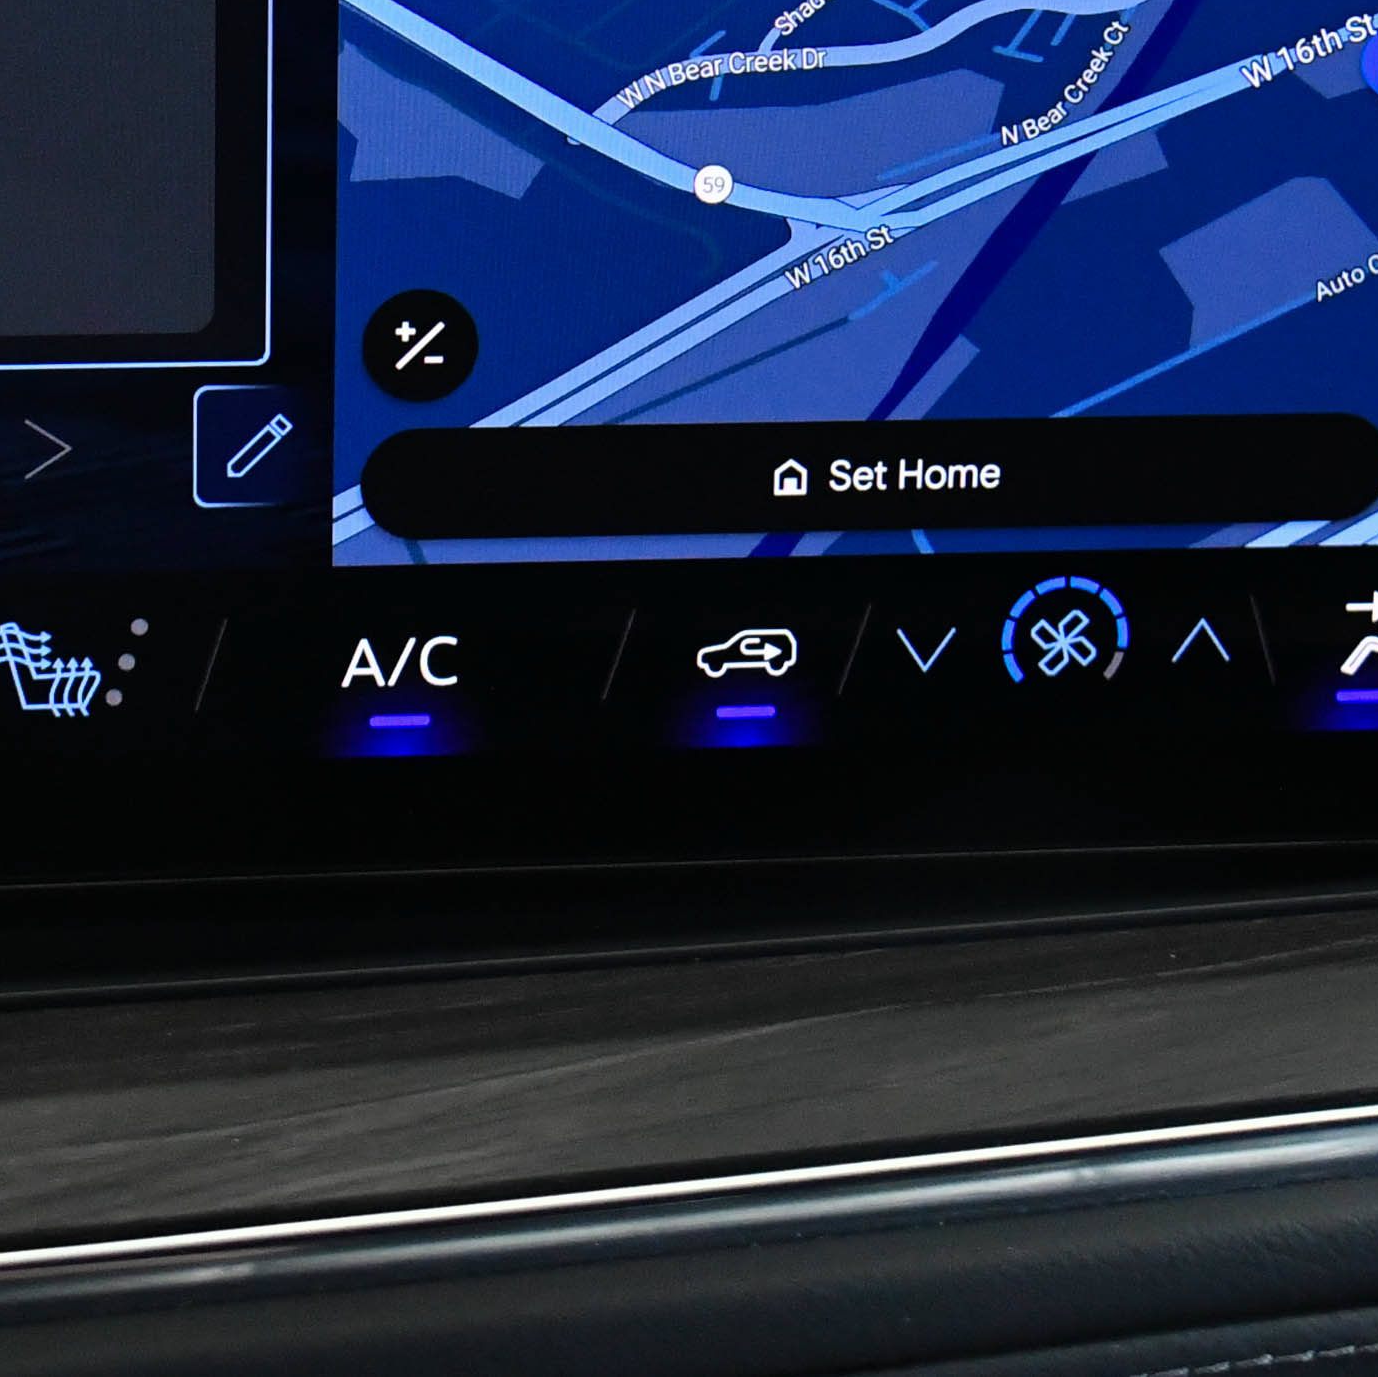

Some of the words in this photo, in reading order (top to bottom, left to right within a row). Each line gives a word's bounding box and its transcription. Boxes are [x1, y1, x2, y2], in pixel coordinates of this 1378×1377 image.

[616, 84, 644, 112] W
[643, 70, 671, 97] N
[667, 54, 724, 85] Bear
[727, 49, 797, 75] Creek
[800, 46, 828, 70] Dr
[1240, 56, 1273, 91] W
[1275, 23, 1344, 75] 16th
[1343, 12, 1378, 46] St
[1000, 124, 1022, 148] N
[1022, 99, 1067, 141] Bear
[1062, 45, 1114, 105] Creek
[1104, 19, 1132, 54] Ct
[701, 175, 726, 194] 59
[784, 260, 814, 291] W
[814, 239, 865, 279] 16th
[863, 223, 895, 252] St
[1314, 263, 1366, 303] Auto
[828, 458, 889, 493] Set
[897, 456, 1002, 492] Home
[341, 636, 460, 691] A/C
